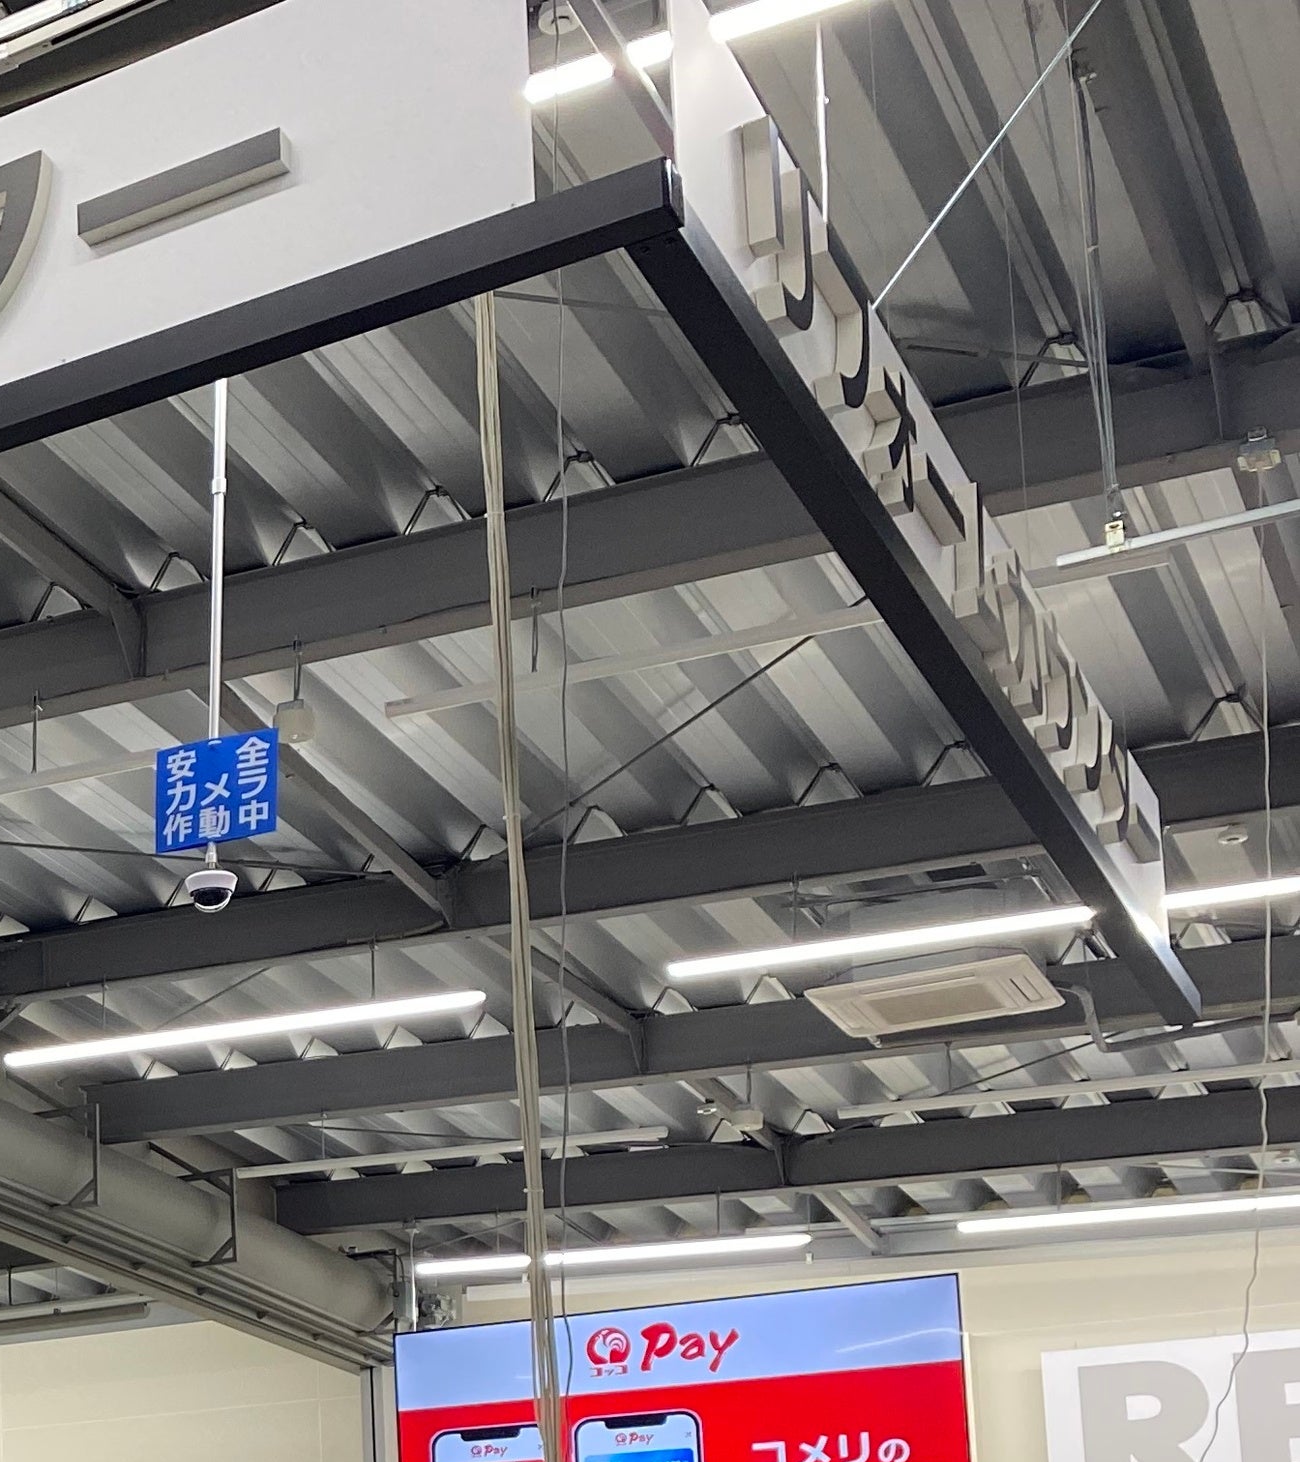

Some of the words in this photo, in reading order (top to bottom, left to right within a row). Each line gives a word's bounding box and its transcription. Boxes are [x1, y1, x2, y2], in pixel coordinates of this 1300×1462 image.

[640, 1321, 740, 1373] Pay
[589, 1364, 628, 1377] コッコ
